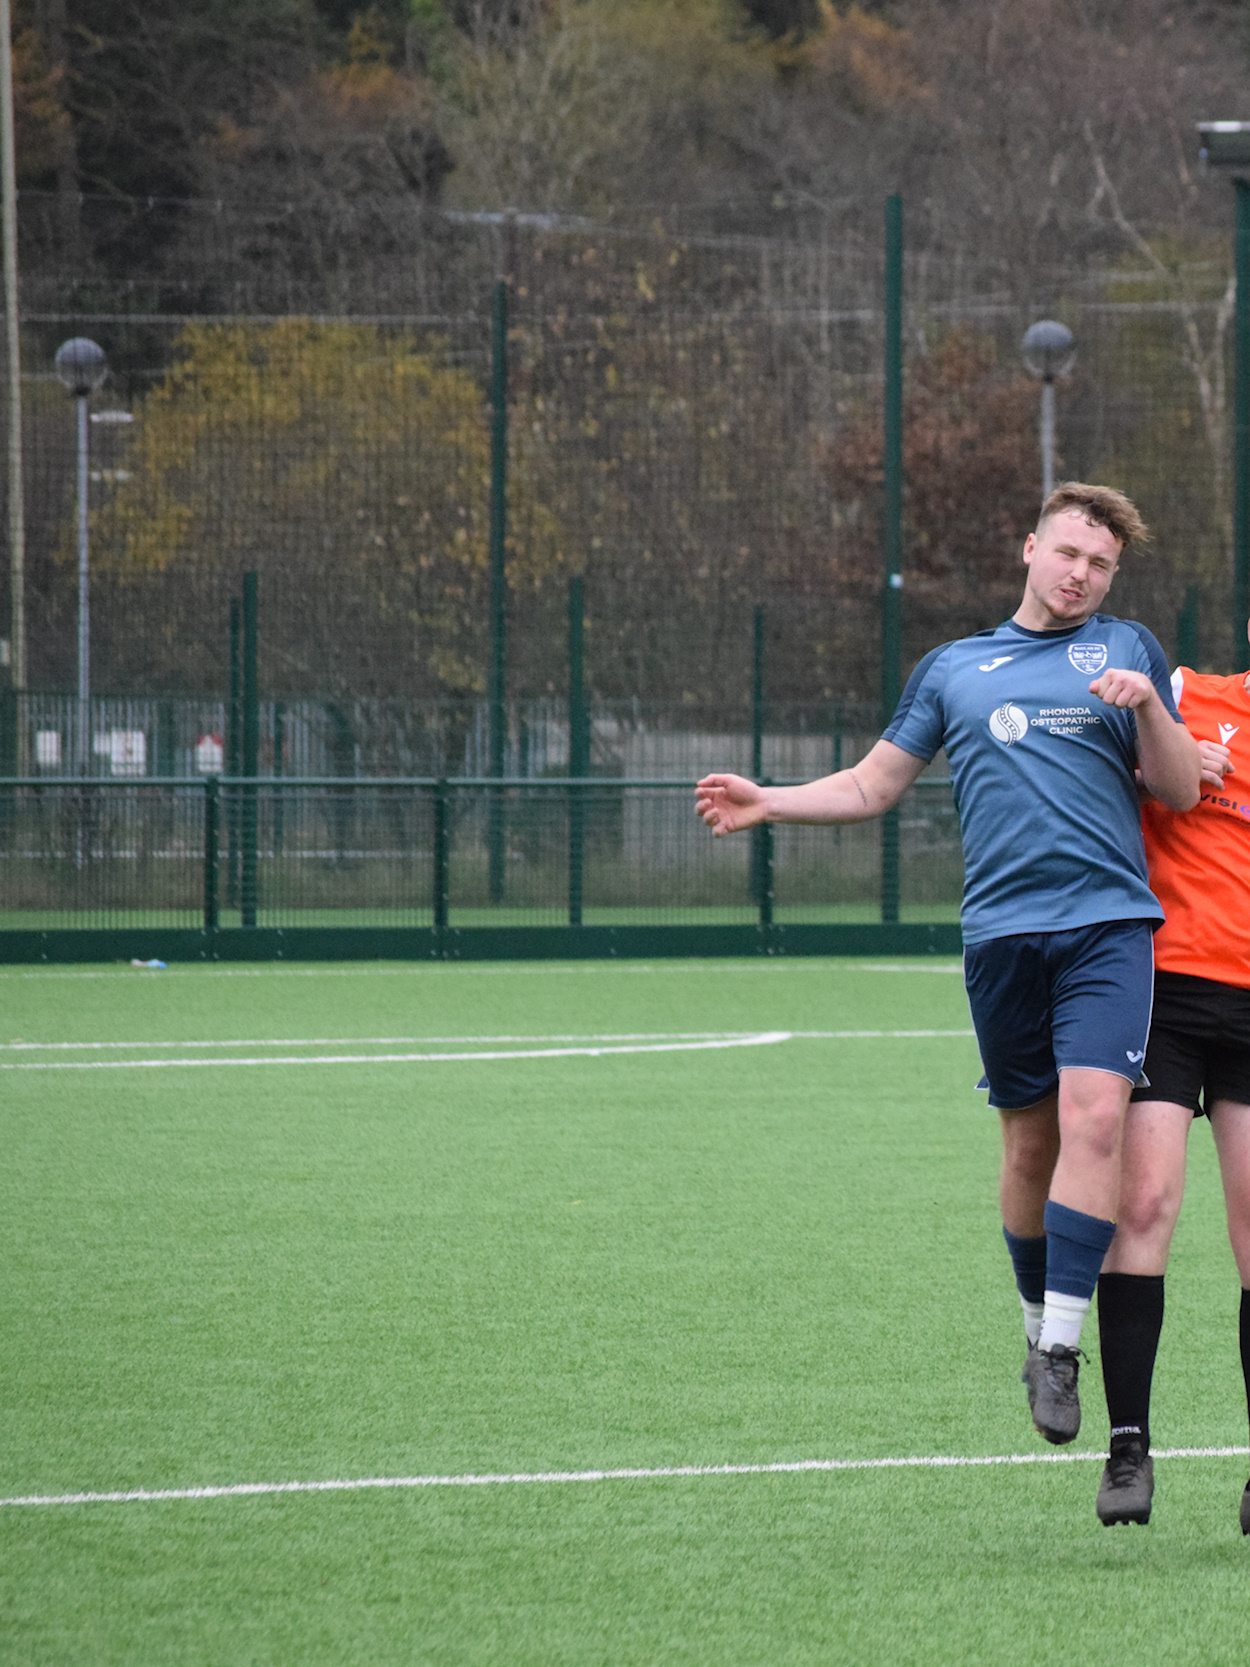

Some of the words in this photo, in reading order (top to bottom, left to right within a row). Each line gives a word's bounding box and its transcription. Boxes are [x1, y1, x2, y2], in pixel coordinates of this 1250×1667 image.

[1039, 707, 1092, 717] RHONDDA
[1030, 716, 1101, 727] OSTEOPATHIC
[1049, 726, 1084, 735] CLINIC
